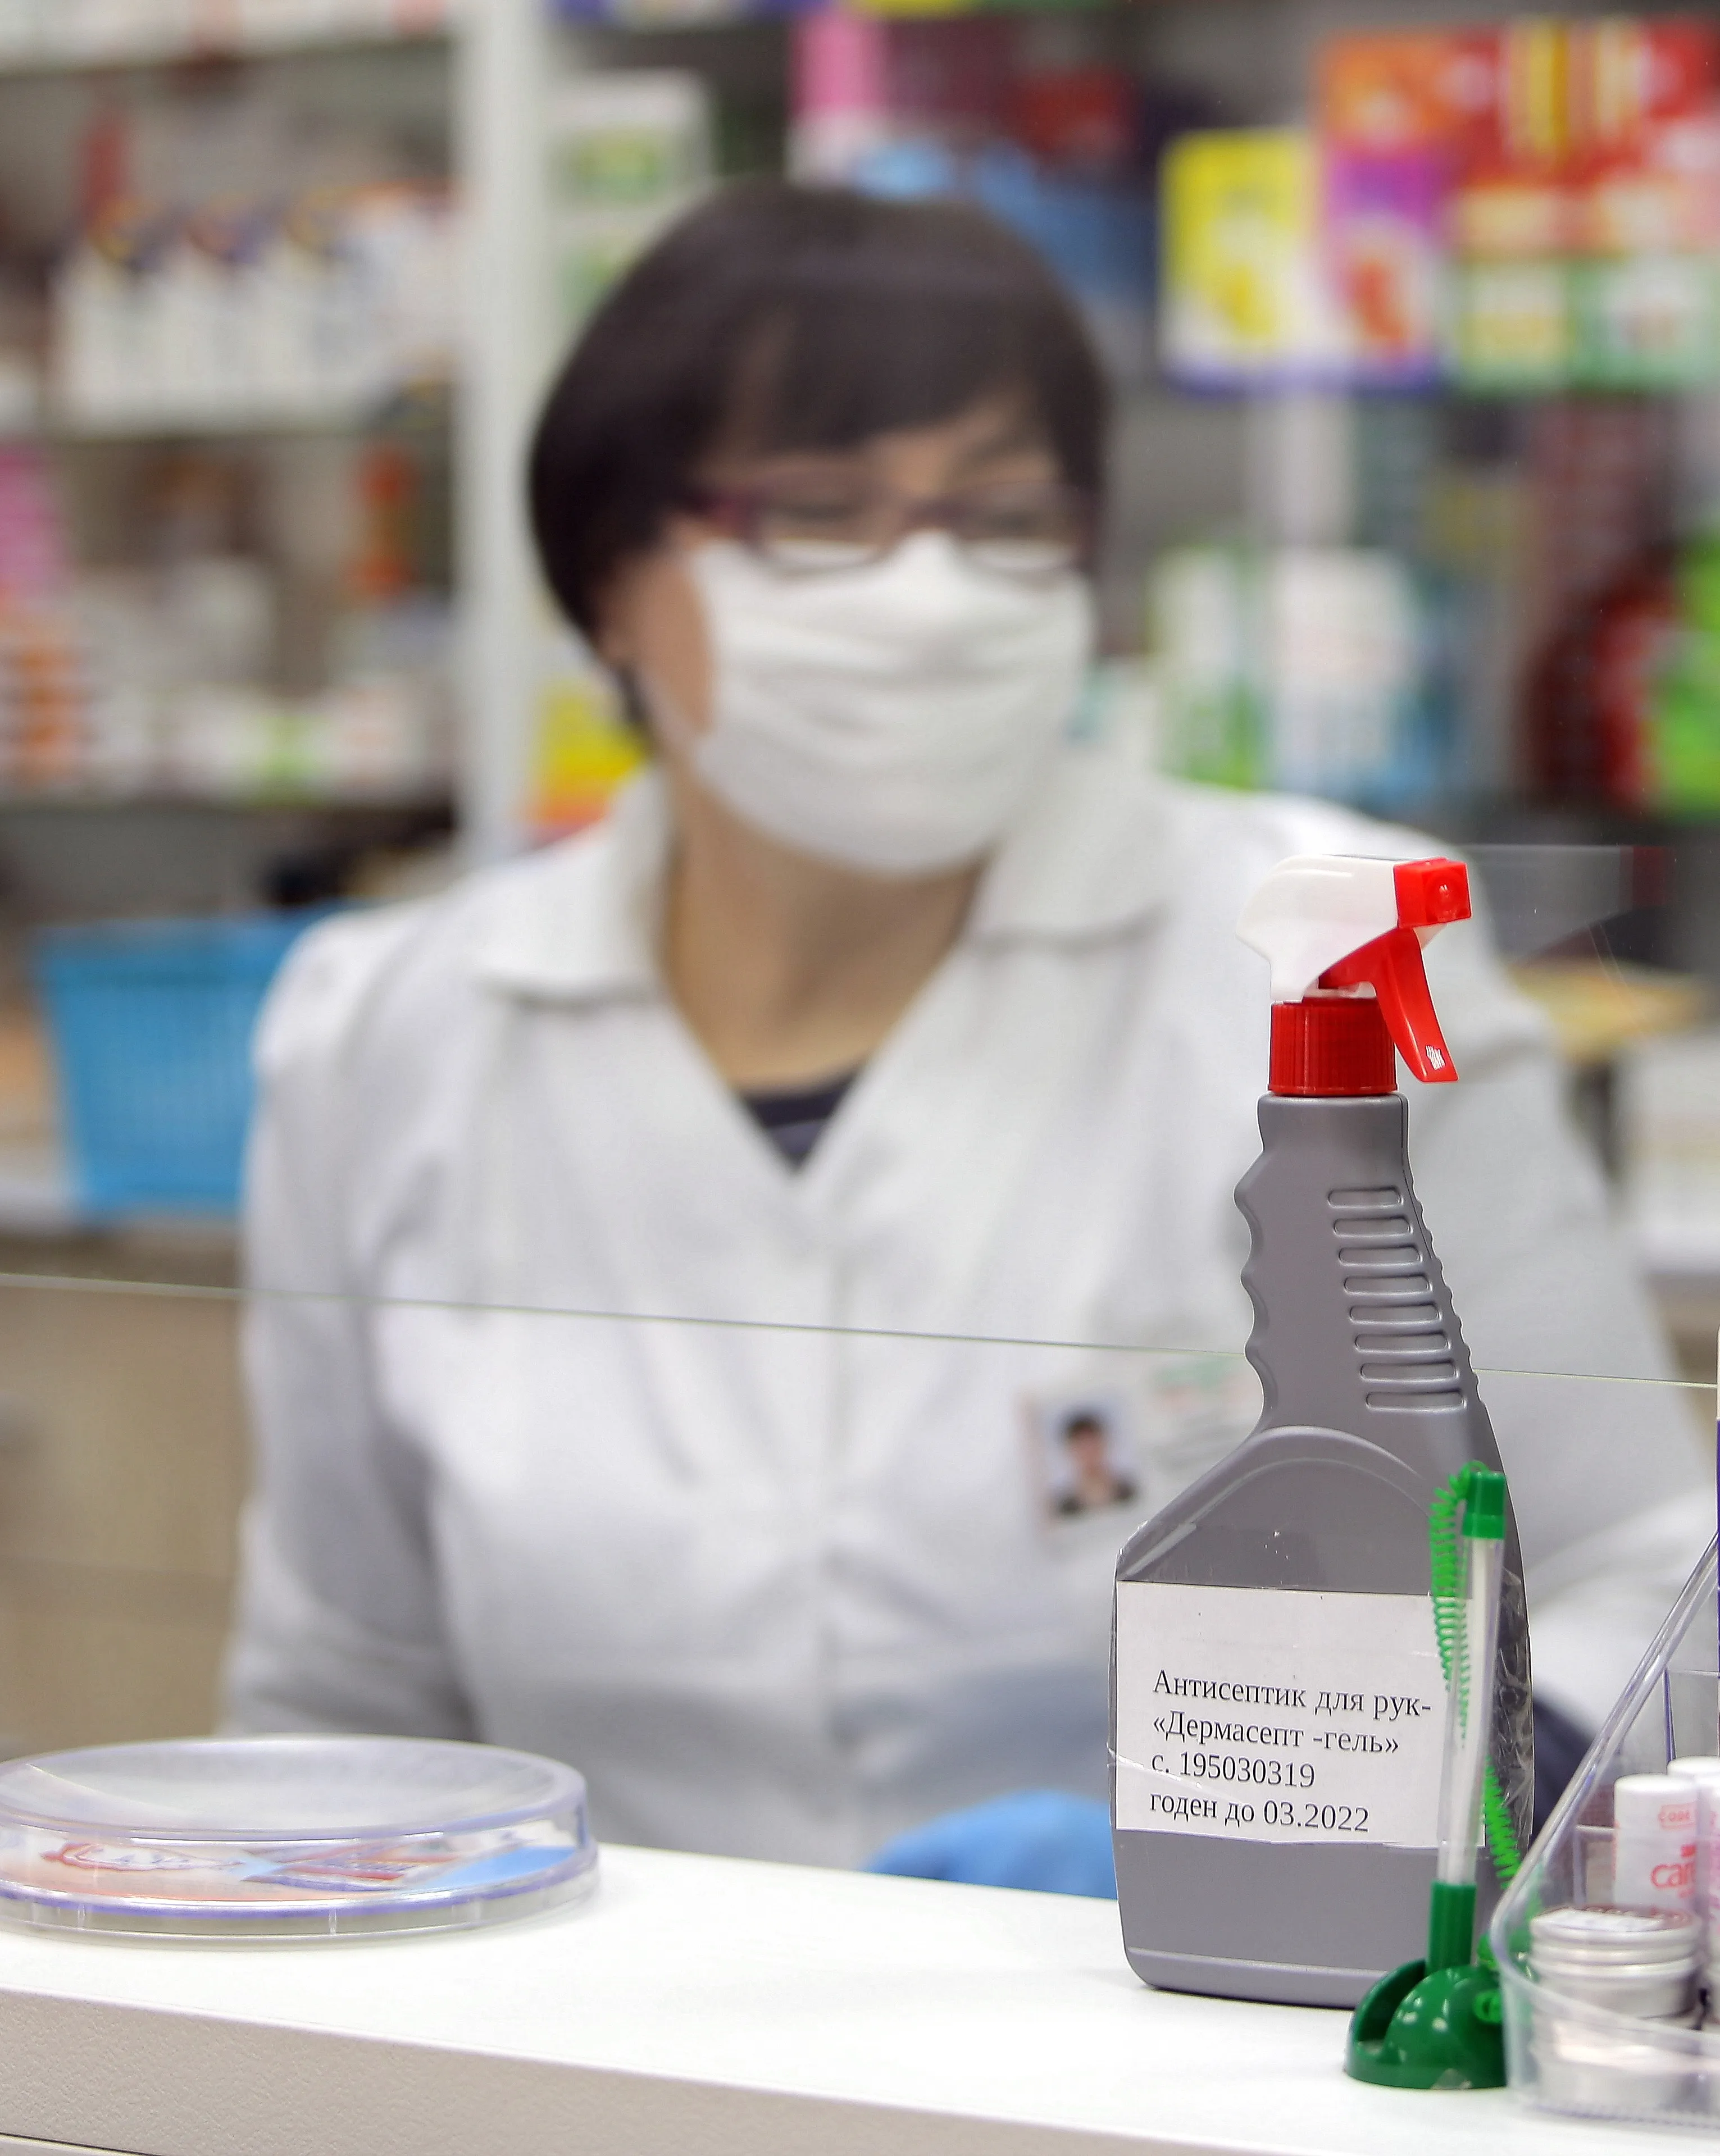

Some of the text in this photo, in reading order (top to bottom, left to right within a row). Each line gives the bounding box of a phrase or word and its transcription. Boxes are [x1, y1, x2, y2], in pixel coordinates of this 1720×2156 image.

[1153, 1669, 1432, 1721] Антисептик для рук-
[1153, 1711, 1399, 1754] «Дермасепт -гель»
[1151, 1751, 1316, 1788] с. 195030319
[1150, 1794, 1369, 1833] годен до 03.2022
